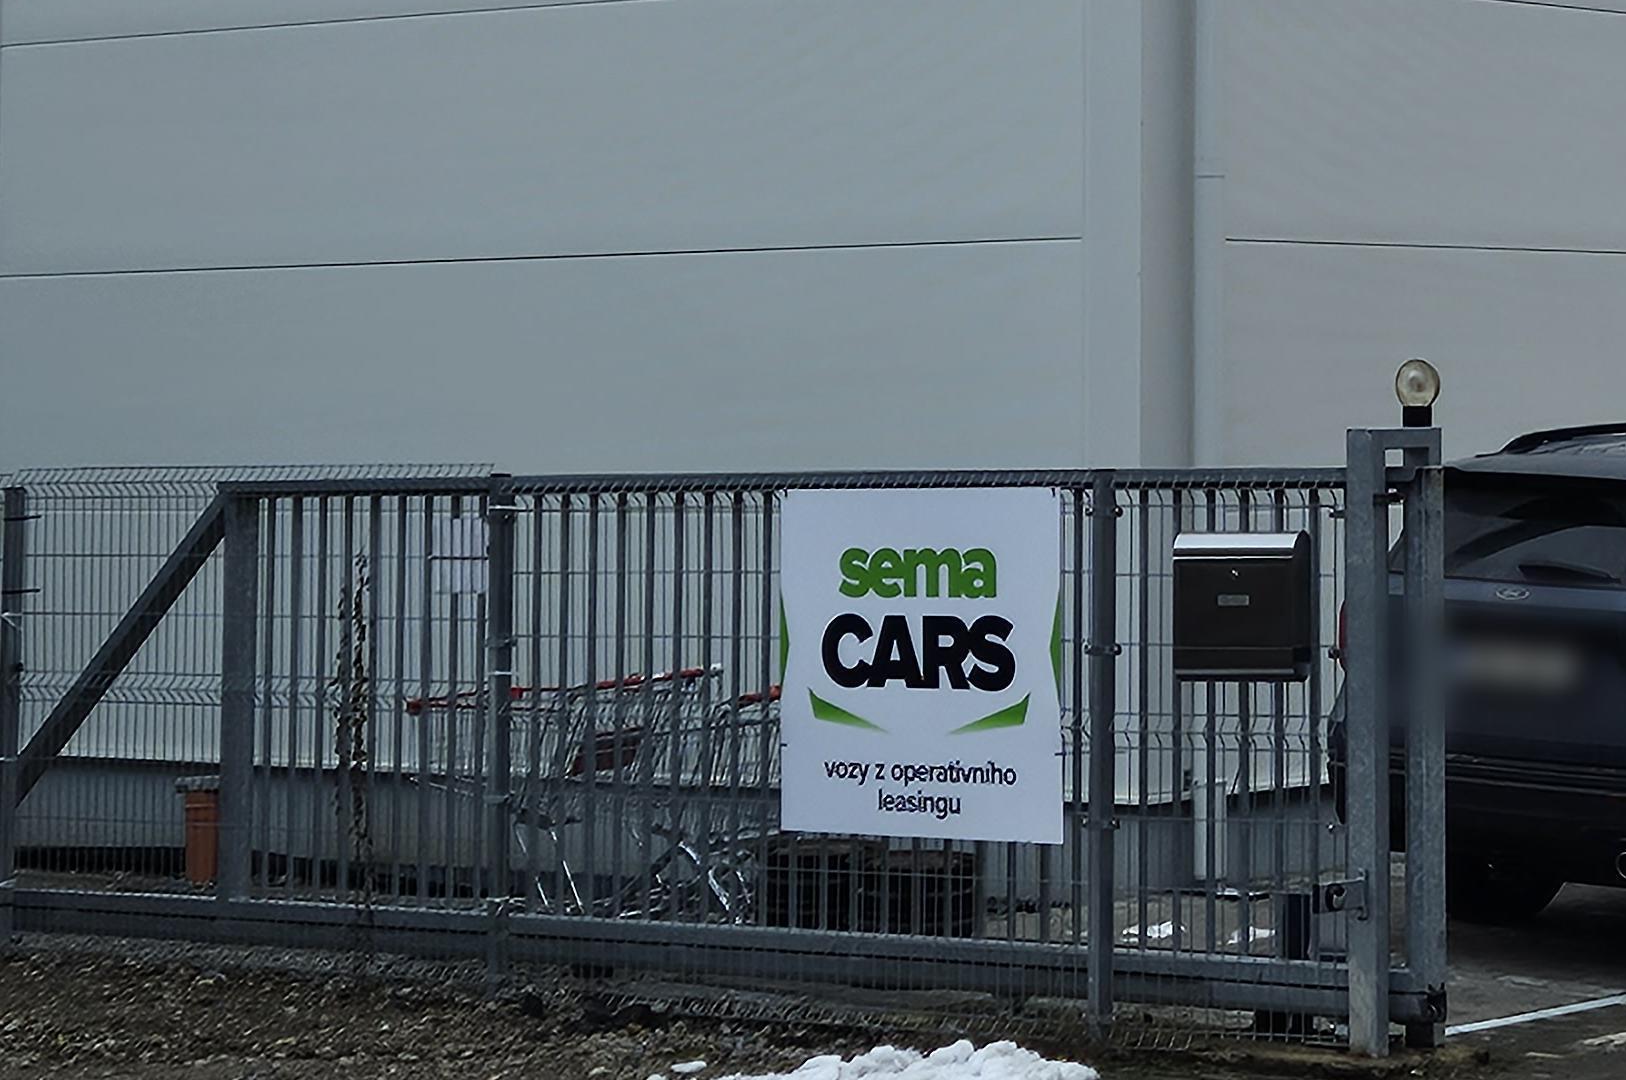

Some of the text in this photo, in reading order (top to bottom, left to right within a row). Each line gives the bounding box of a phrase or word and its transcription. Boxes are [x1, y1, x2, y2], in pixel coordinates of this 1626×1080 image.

[839, 547, 997, 598] sema
[822, 613, 1016, 692] CARS
[824, 759, 1017, 787] vozy z operativního
[878, 788, 961, 820] leasingu
